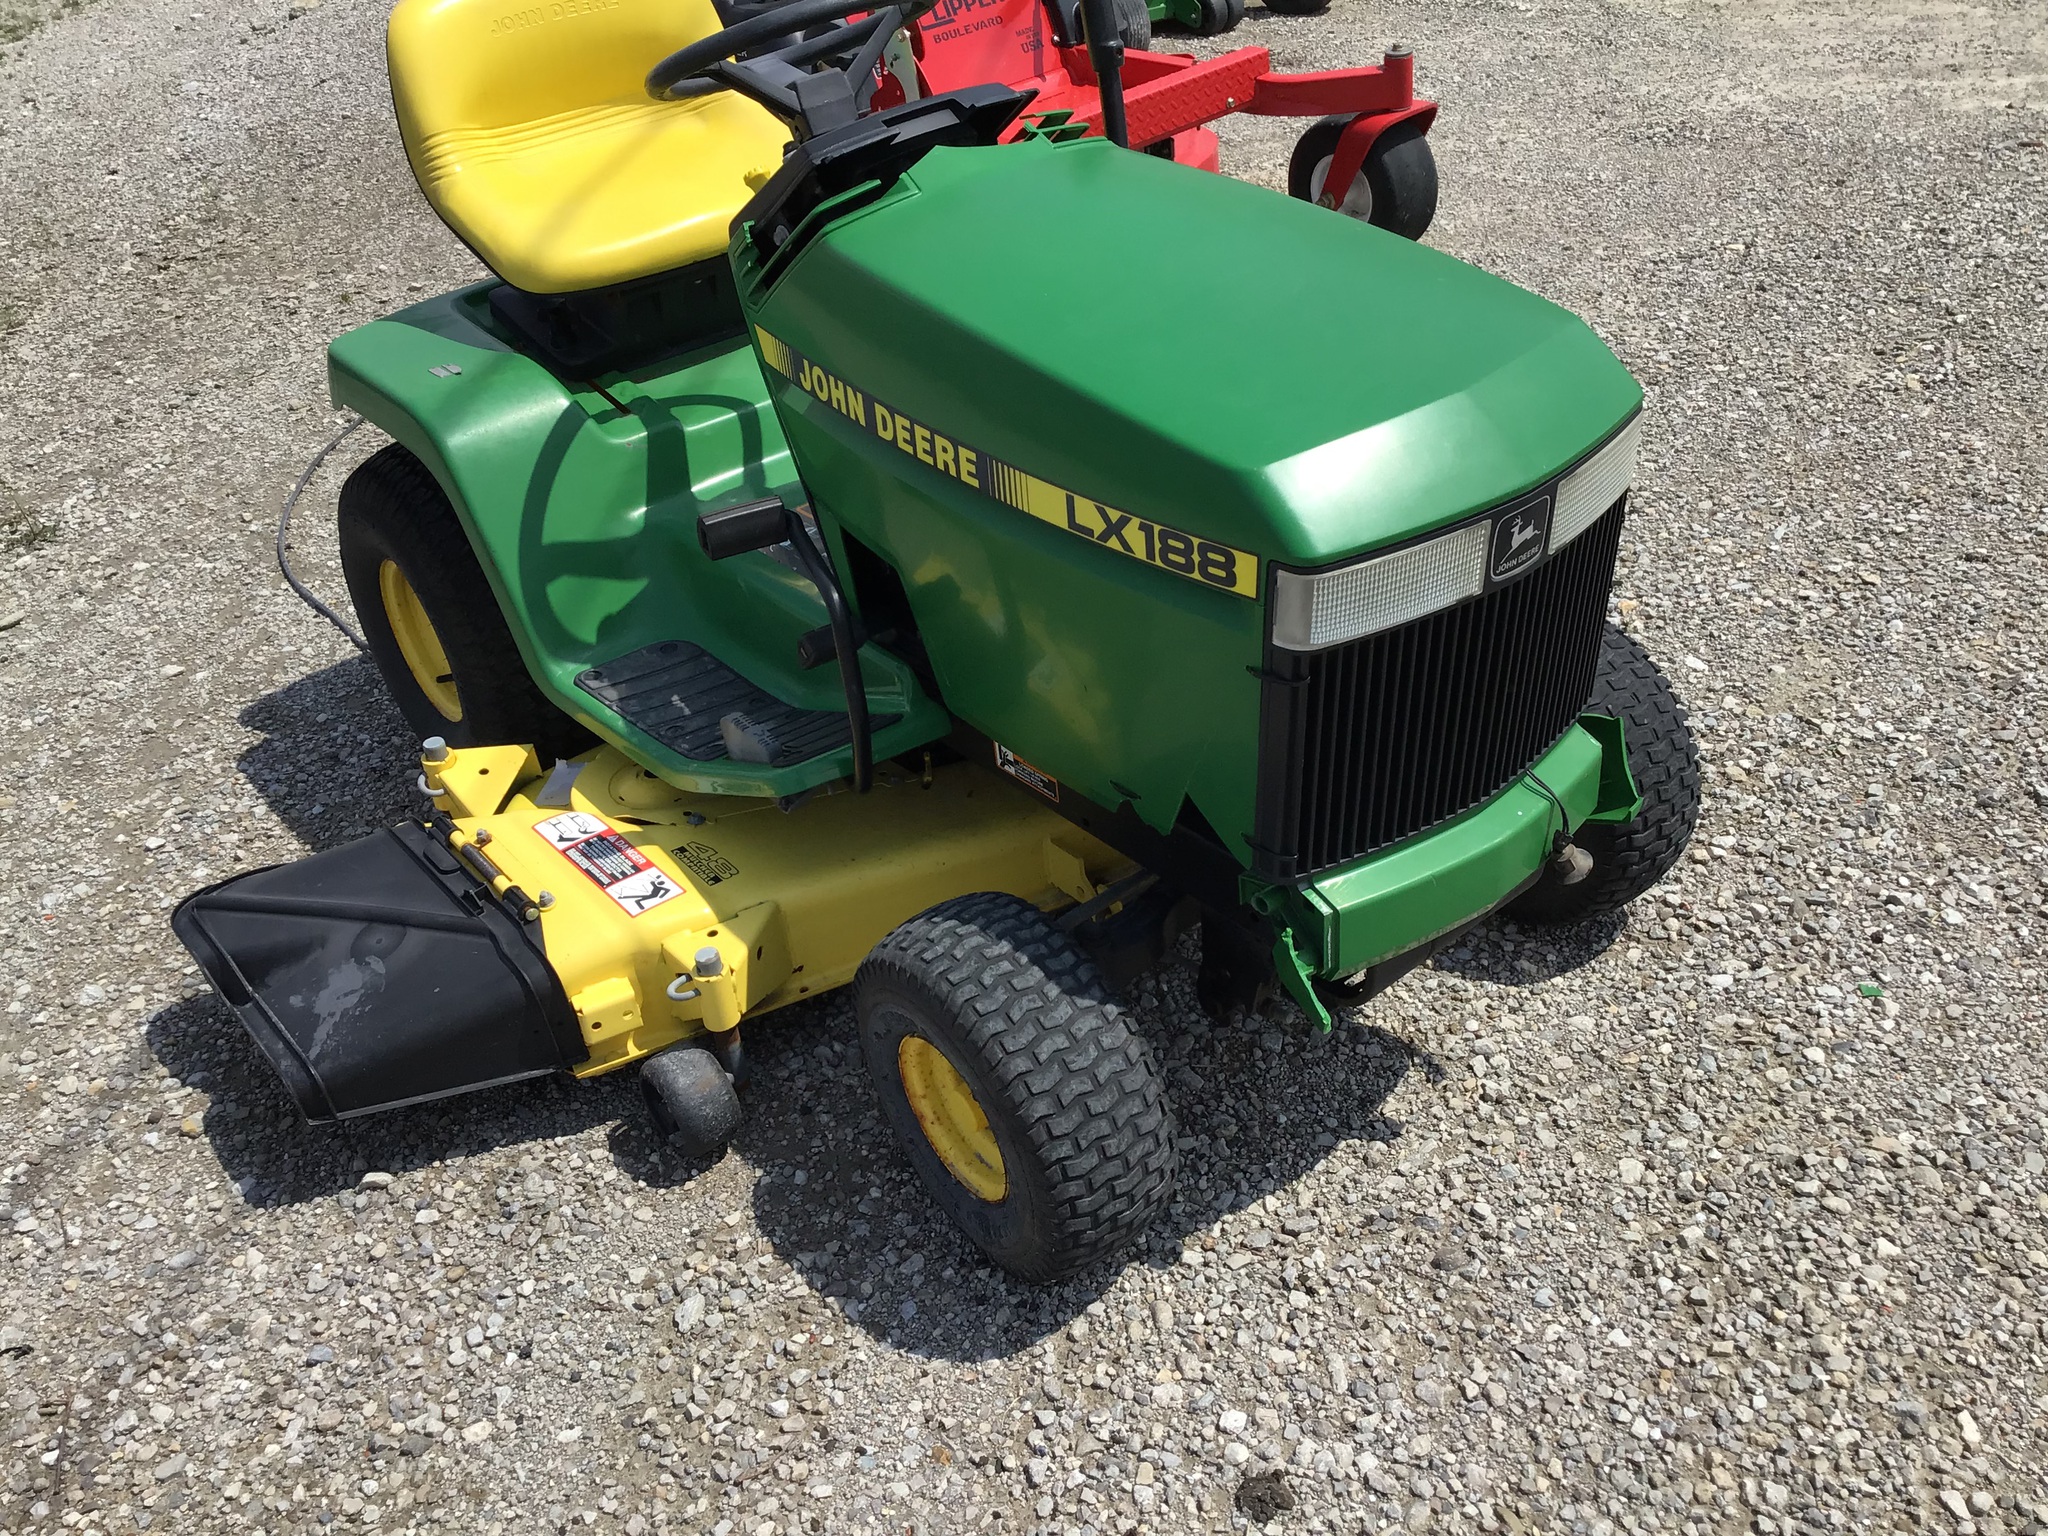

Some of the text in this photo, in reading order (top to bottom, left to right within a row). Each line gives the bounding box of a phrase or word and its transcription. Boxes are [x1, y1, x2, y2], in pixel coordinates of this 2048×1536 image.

[491, 7, 545, 38] JOHN
[921, 0, 1004, 31] LIPP
[932, 15, 1004, 44] BOULEVARD
[1020, 38, 1044, 53] USA
[799, 358, 981, 489] JOHN DEERE
[1065, 492, 1238, 588] LX188
[1496, 544, 1540, 574] JOHN DEERE
[614, 840, 647, 865] DANGER
[673, 850, 716, 886] COMPATIBLE
[683, 851, 716, 878] MULCHER
[686, 840, 740, 880] 48
